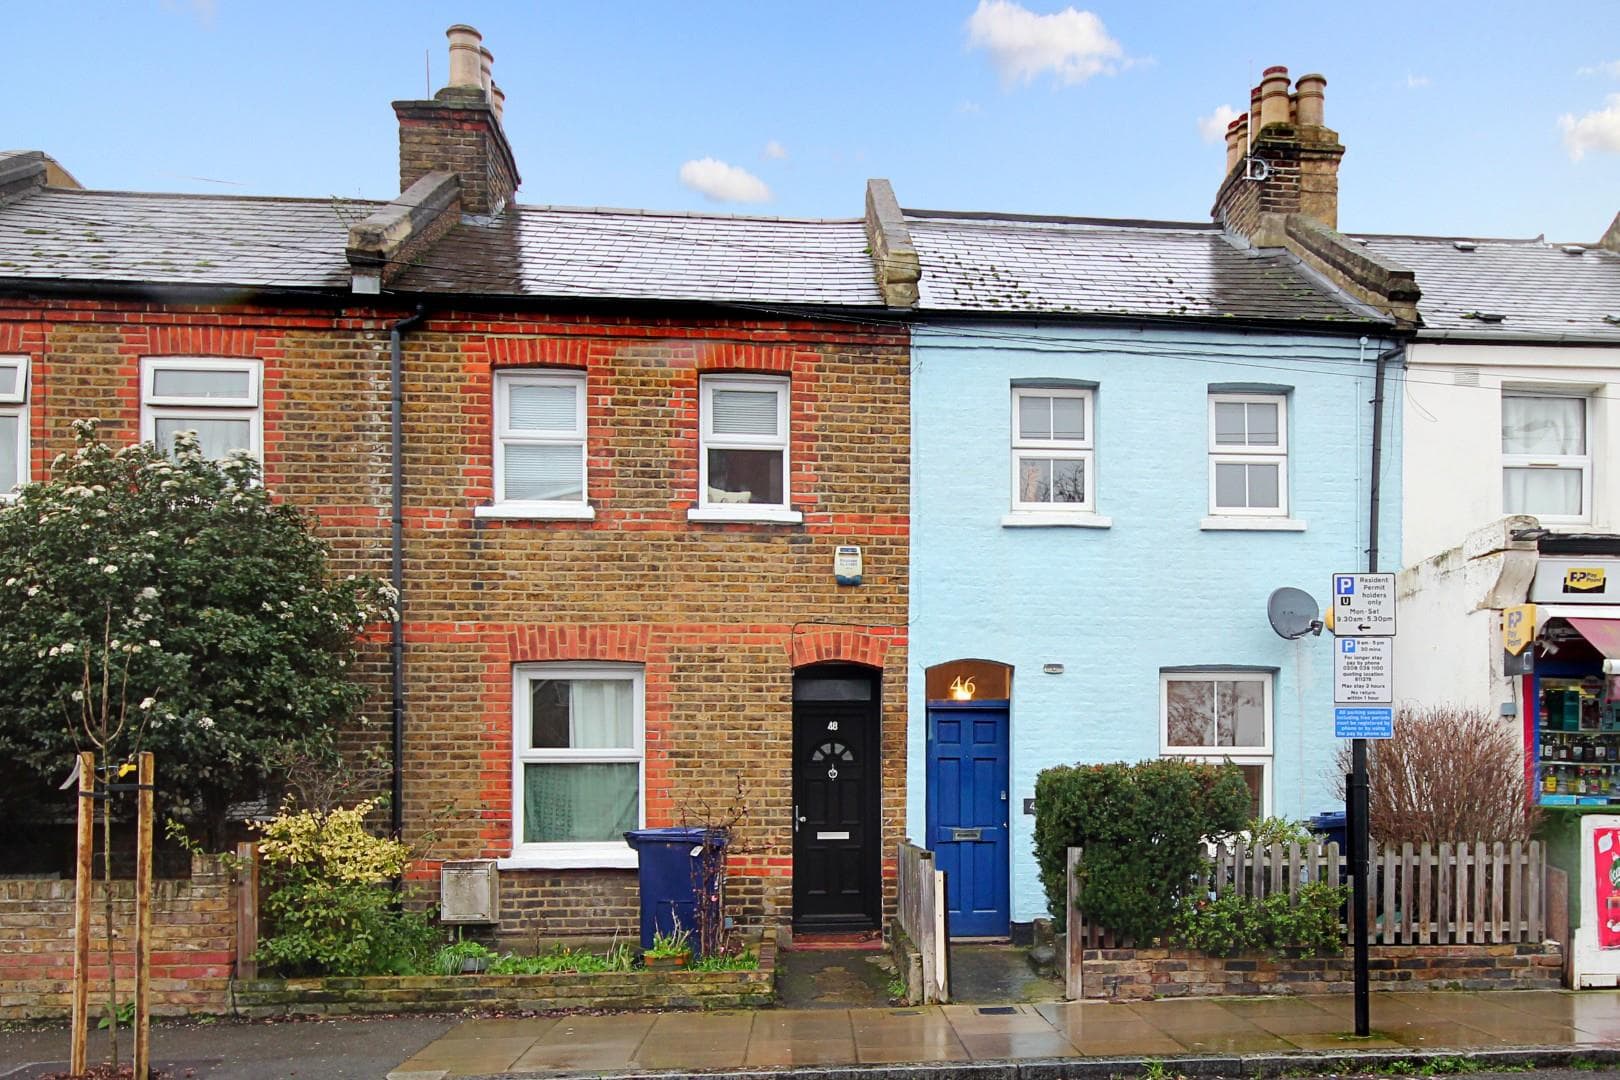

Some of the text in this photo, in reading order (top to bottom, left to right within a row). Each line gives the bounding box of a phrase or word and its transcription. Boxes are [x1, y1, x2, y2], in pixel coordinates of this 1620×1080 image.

[1341, 578, 1352, 593] P
[1342, 597, 1349, 605] U
[1344, 641, 1354, 652] P
[950, 675, 976, 695] 46
[827, 720, 838, 731] 48
